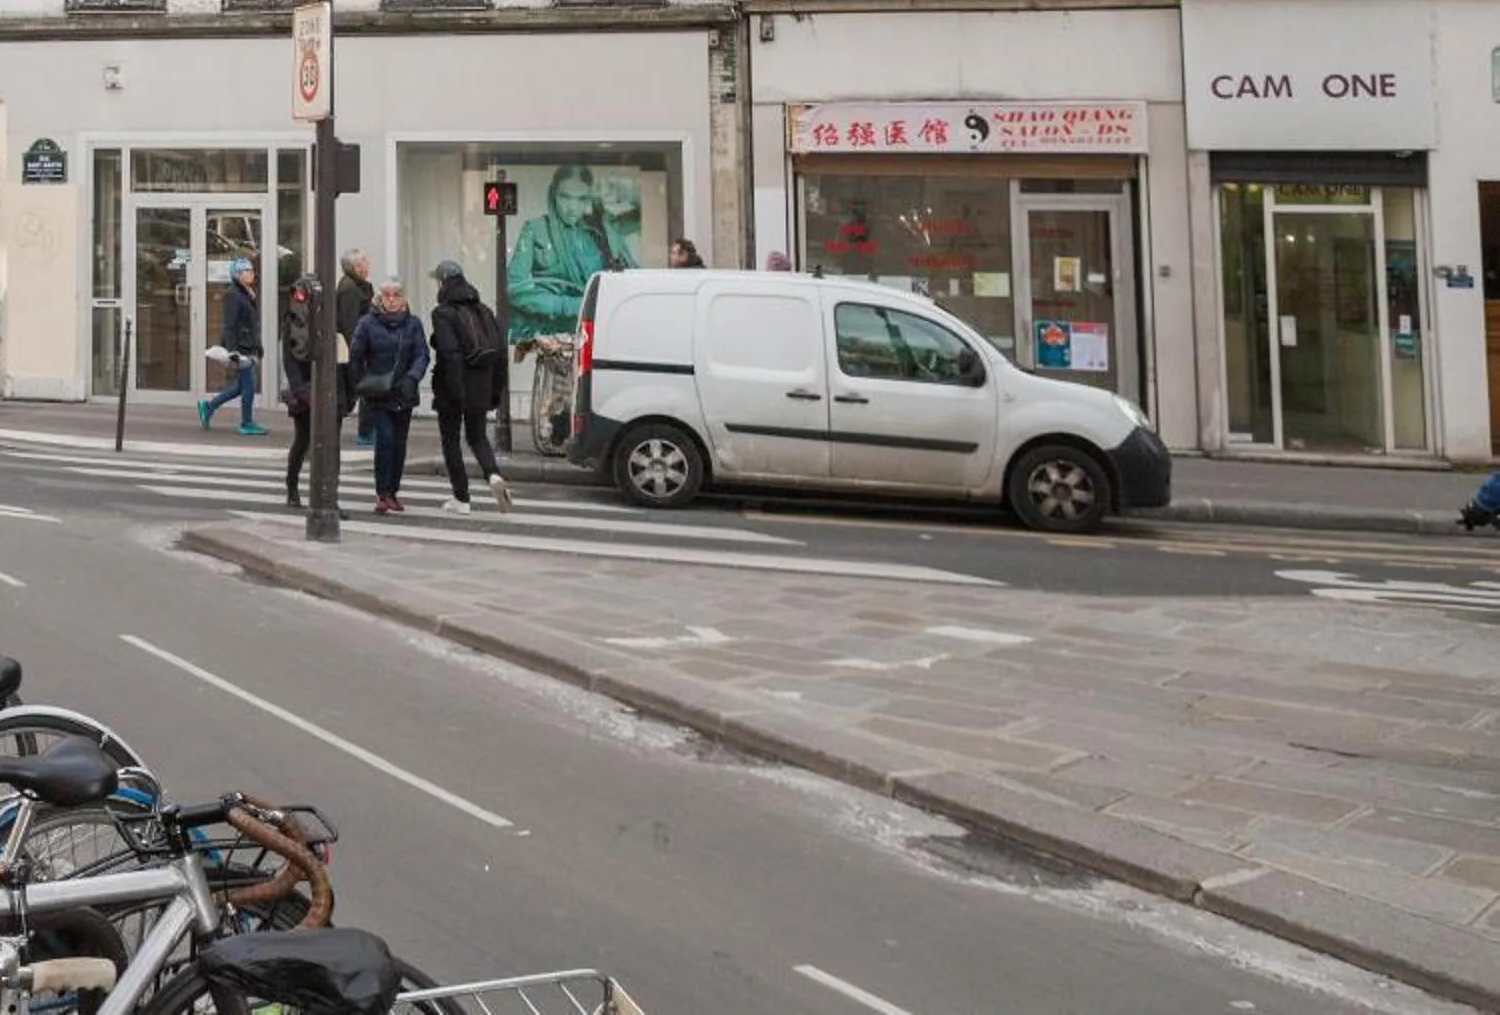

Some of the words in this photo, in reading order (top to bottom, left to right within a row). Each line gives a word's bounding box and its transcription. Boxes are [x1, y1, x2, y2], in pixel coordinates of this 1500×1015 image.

[1210, 73, 1293, 99] CAM
[1321, 72, 1397, 98] ONE
[993, 110, 1055, 123] SHAO
[1062, 109, 1133, 125] QIANG
